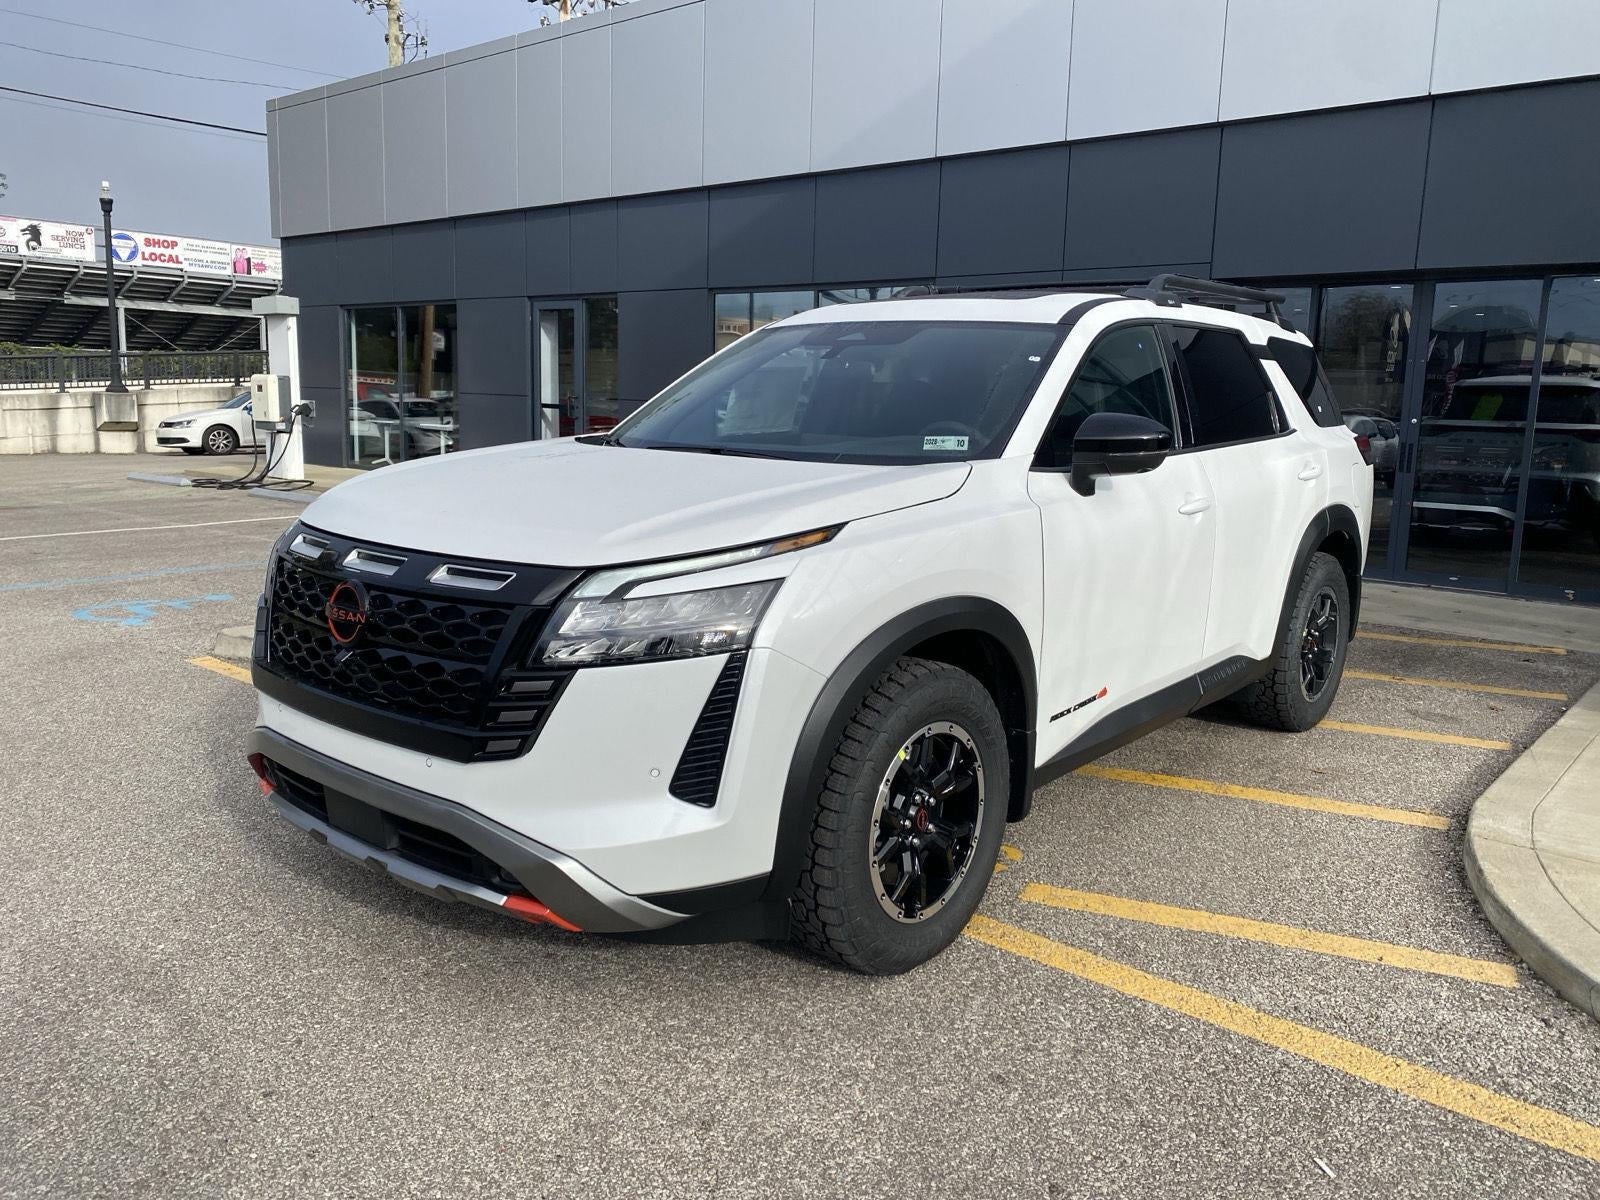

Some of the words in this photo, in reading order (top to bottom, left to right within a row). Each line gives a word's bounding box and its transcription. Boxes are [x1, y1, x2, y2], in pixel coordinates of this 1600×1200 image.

[51, 235, 84, 243] SERVING
[144, 238, 178, 249] SHOP
[59, 242, 85, 250] LUNCH
[141, 251, 183, 265] LOCAL
[956, 439, 965, 447] 10
[1049, 707, 1072, 723] ROCK
[1073, 694, 1097, 711] CREEK
